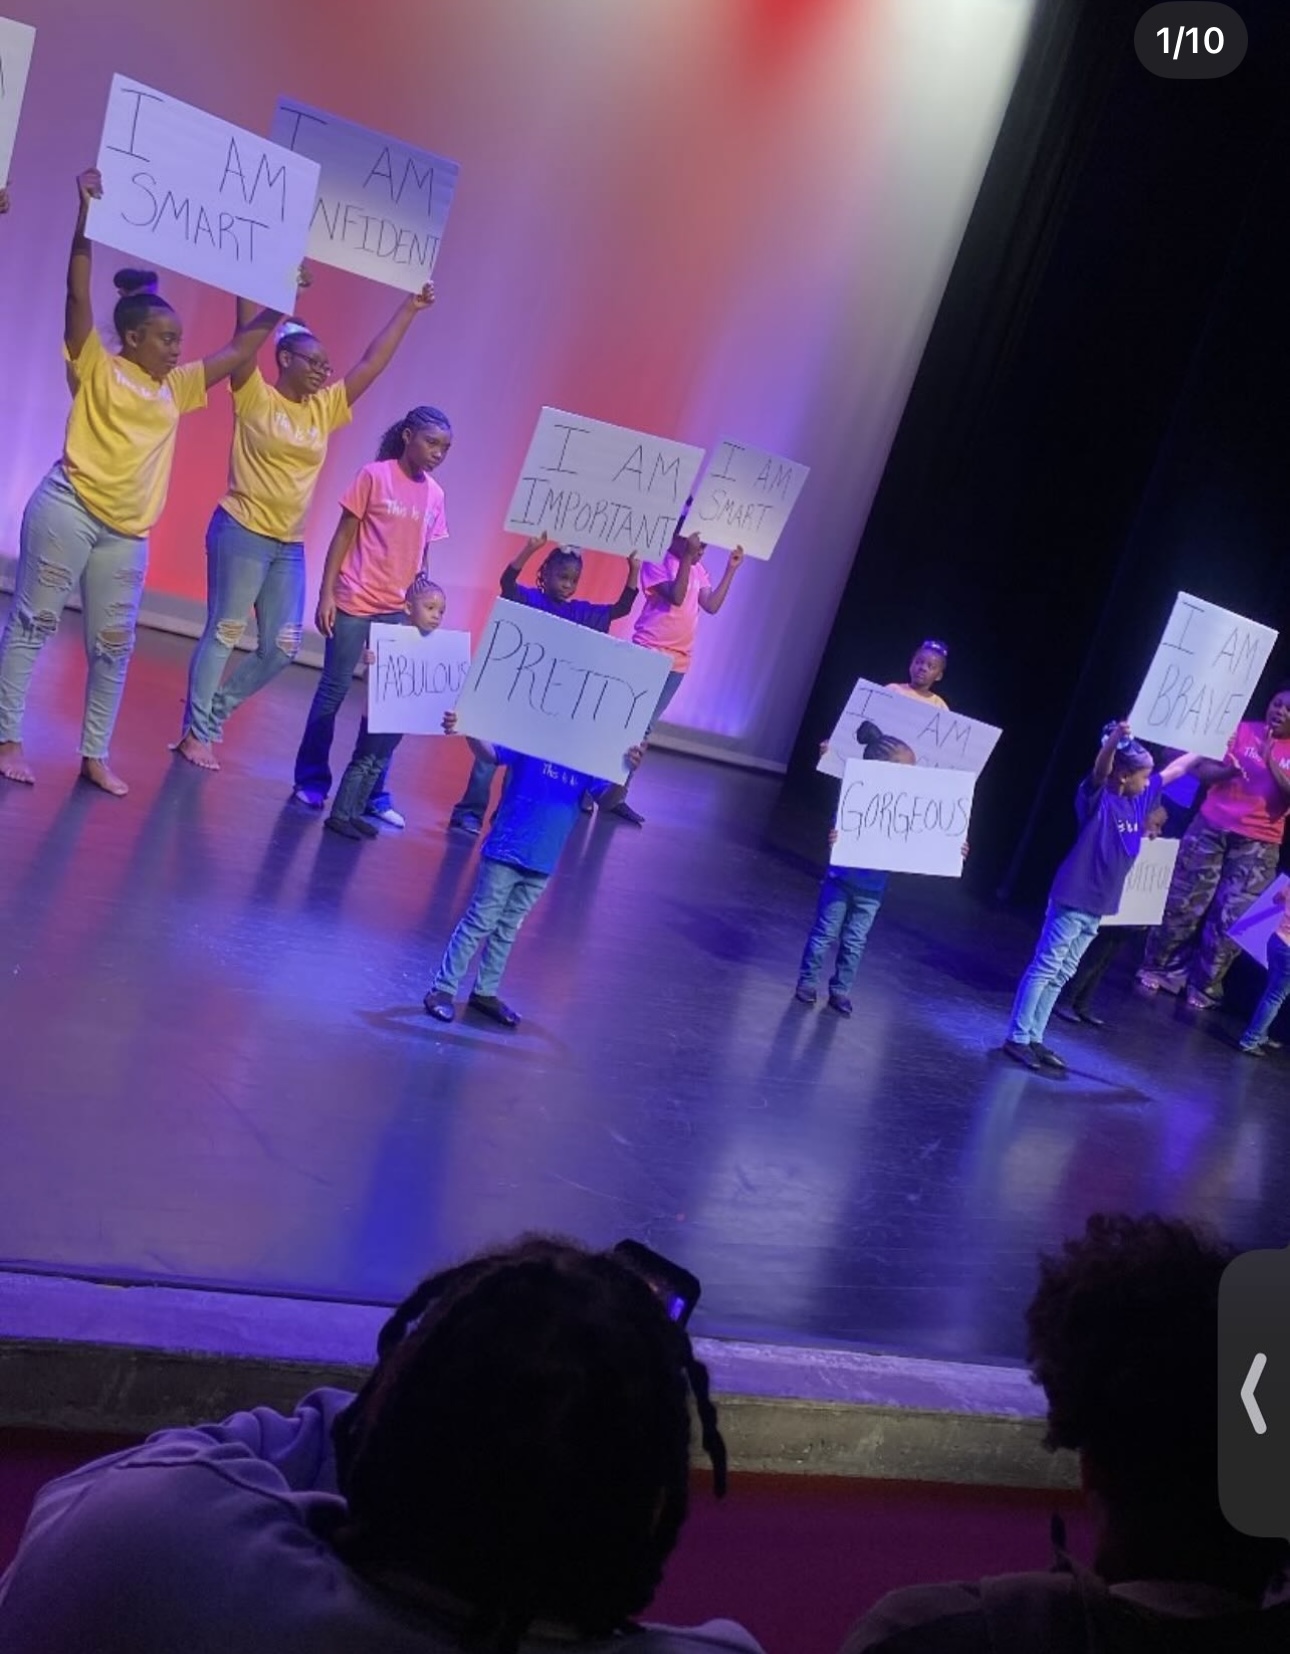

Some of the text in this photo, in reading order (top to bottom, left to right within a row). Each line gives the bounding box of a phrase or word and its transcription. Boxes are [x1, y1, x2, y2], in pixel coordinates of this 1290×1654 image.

[106, 88, 287, 222] I AM
[363, 147, 435, 216] AM
[121, 173, 270, 262] SMART
[309, 198, 440, 270] NFIDENT
[538, 424, 680, 502] I AM
[711, 441, 793, 502] I AM
[510, 477, 677, 556] IMPORTANT
[699, 489, 774, 532] SMART
[474, 618, 648, 729] PRETTY
[1162, 601, 1259, 687] I AM
[846, 687, 973, 757] I AM
[1147, 663, 1245, 736] BRAVE
[840, 780, 969, 843] GORGEOUS
